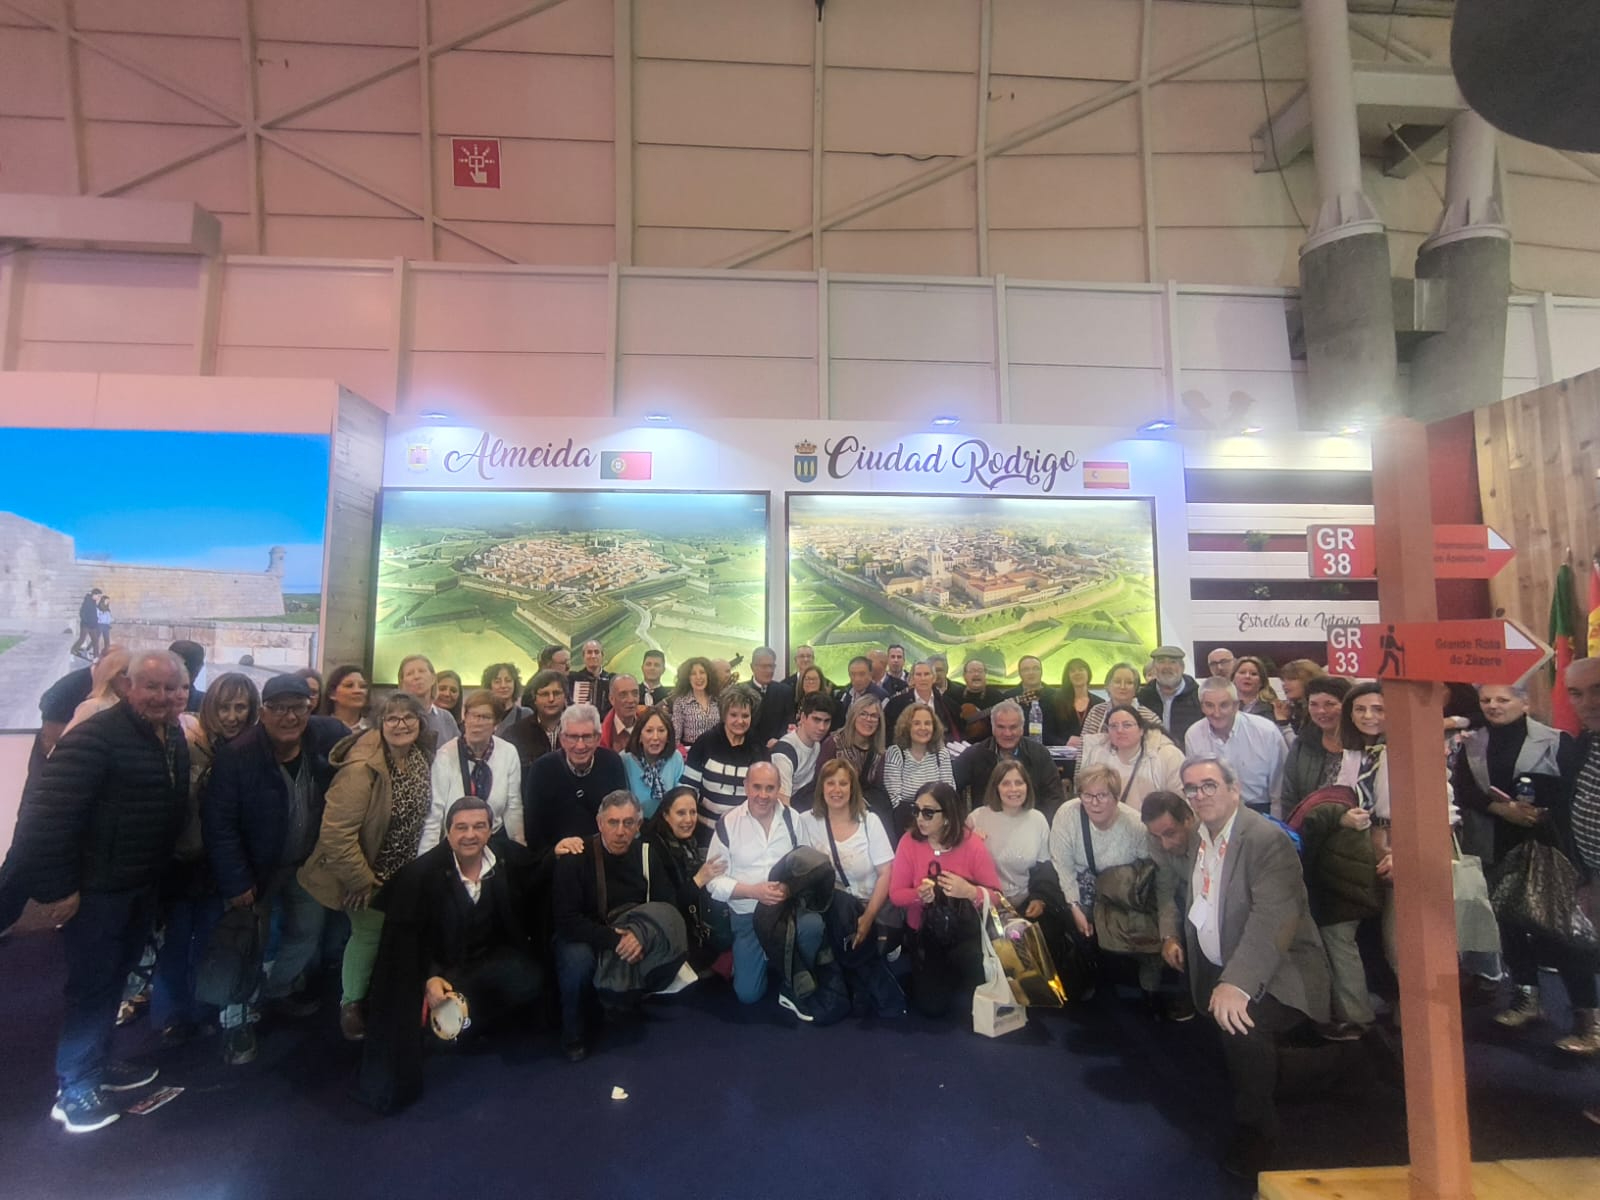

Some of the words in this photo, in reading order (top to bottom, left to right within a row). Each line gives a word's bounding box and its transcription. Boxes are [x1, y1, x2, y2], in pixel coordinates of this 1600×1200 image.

[444, 431, 597, 480] Almeida
[824, 435, 948, 479] Ciudad
[952, 439, 1078, 492] Rodrigo
[1317, 528, 1356, 550] GR
[1323, 553, 1351, 575] 38
[1238, 612, 1290, 632] Estrellas
[1294, 615, 1310, 628] de
[1330, 628, 1362, 648] GR
[1335, 651, 1359, 673] 33
